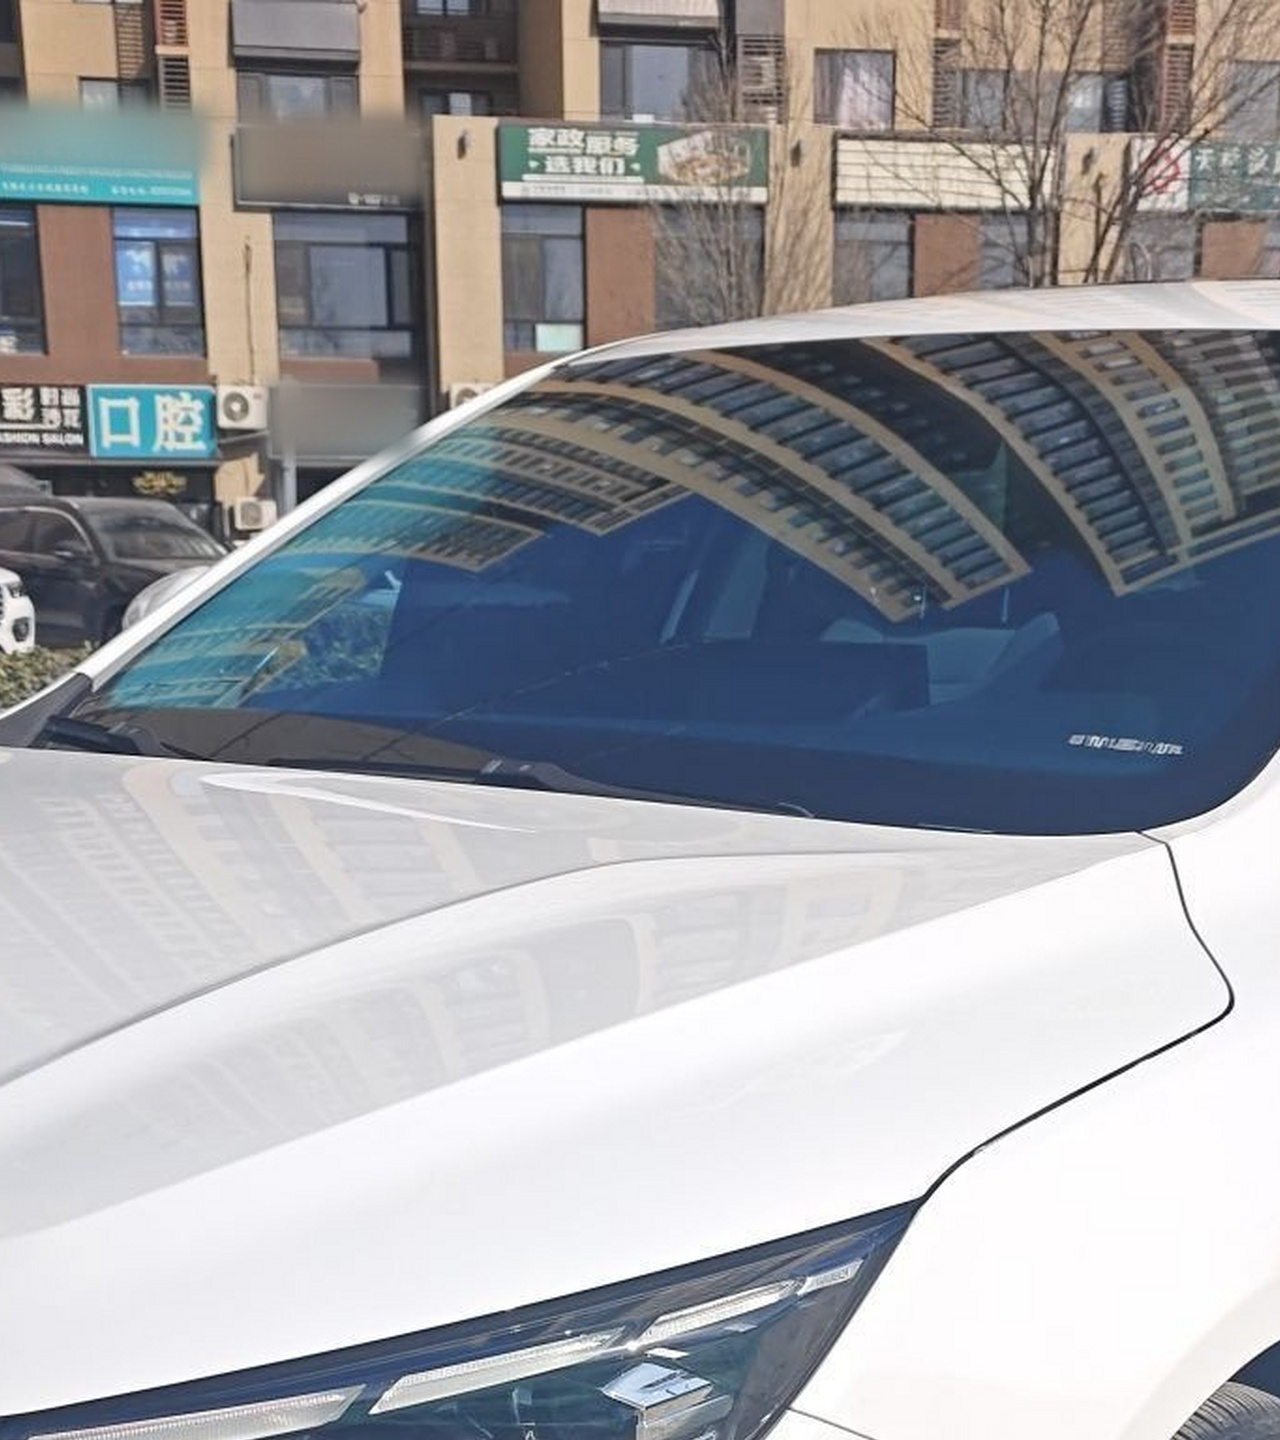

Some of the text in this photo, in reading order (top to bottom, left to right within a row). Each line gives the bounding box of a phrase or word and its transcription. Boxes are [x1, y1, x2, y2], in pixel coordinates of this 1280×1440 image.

[528, 128, 639, 156] 家政服务
[545, 155, 625, 175] 选我们
[98, 391, 208, 453] 口腔
[42, 432, 84, 445] SALON
